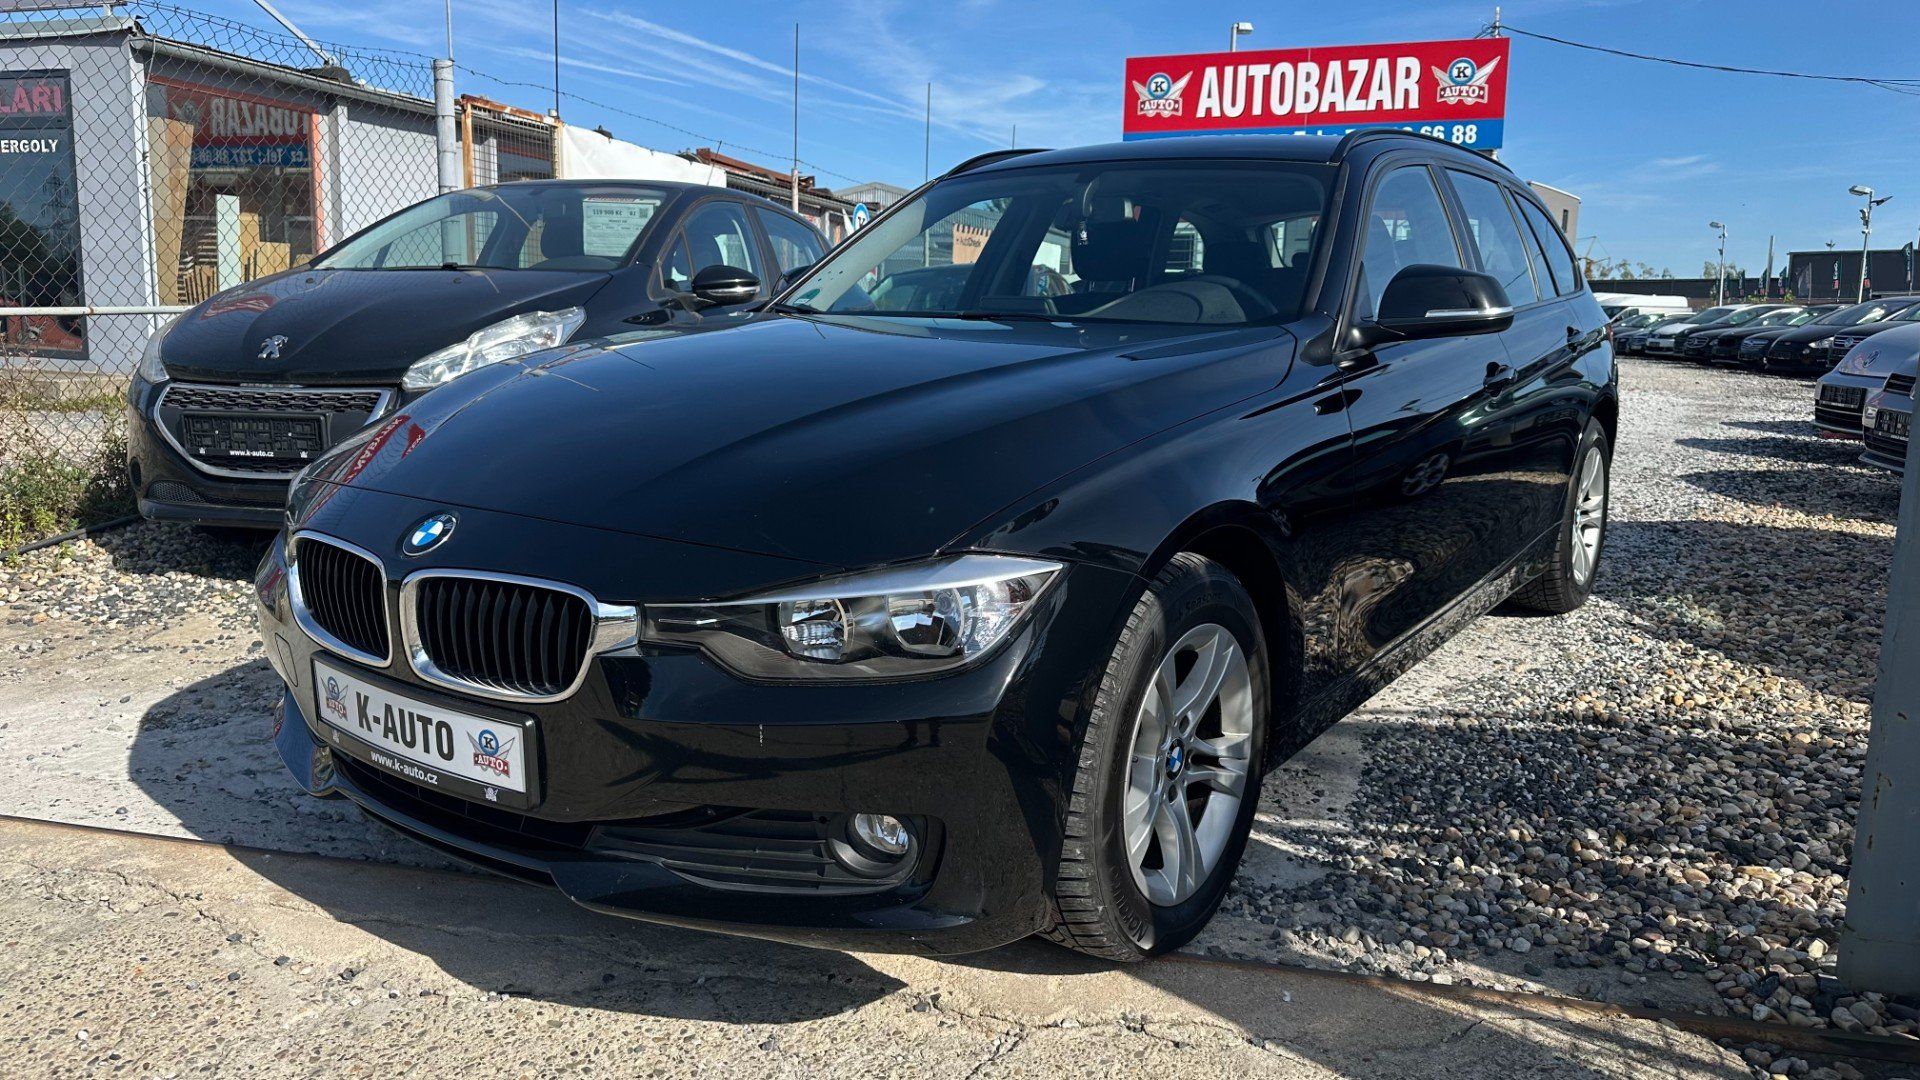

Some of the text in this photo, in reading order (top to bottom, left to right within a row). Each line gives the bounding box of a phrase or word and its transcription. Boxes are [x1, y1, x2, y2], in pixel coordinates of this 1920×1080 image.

[1455, 66, 1469, 78] K
[1153, 81, 1165, 92] K
[1196, 57, 1421, 118] AUTOBAZAR
[1444, 86, 1479, 97] AUTO
[1144, 100, 1175, 110] AUTO
[1452, 124, 1478, 144] 88
[229, 449, 275, 458] www.k-auto.cz
[355, 691, 455, 762] K-AUTO
[483, 736, 495, 750] K
[370, 750, 438, 785] www.k-auto.cz
[478, 754, 504, 771] AUTO
